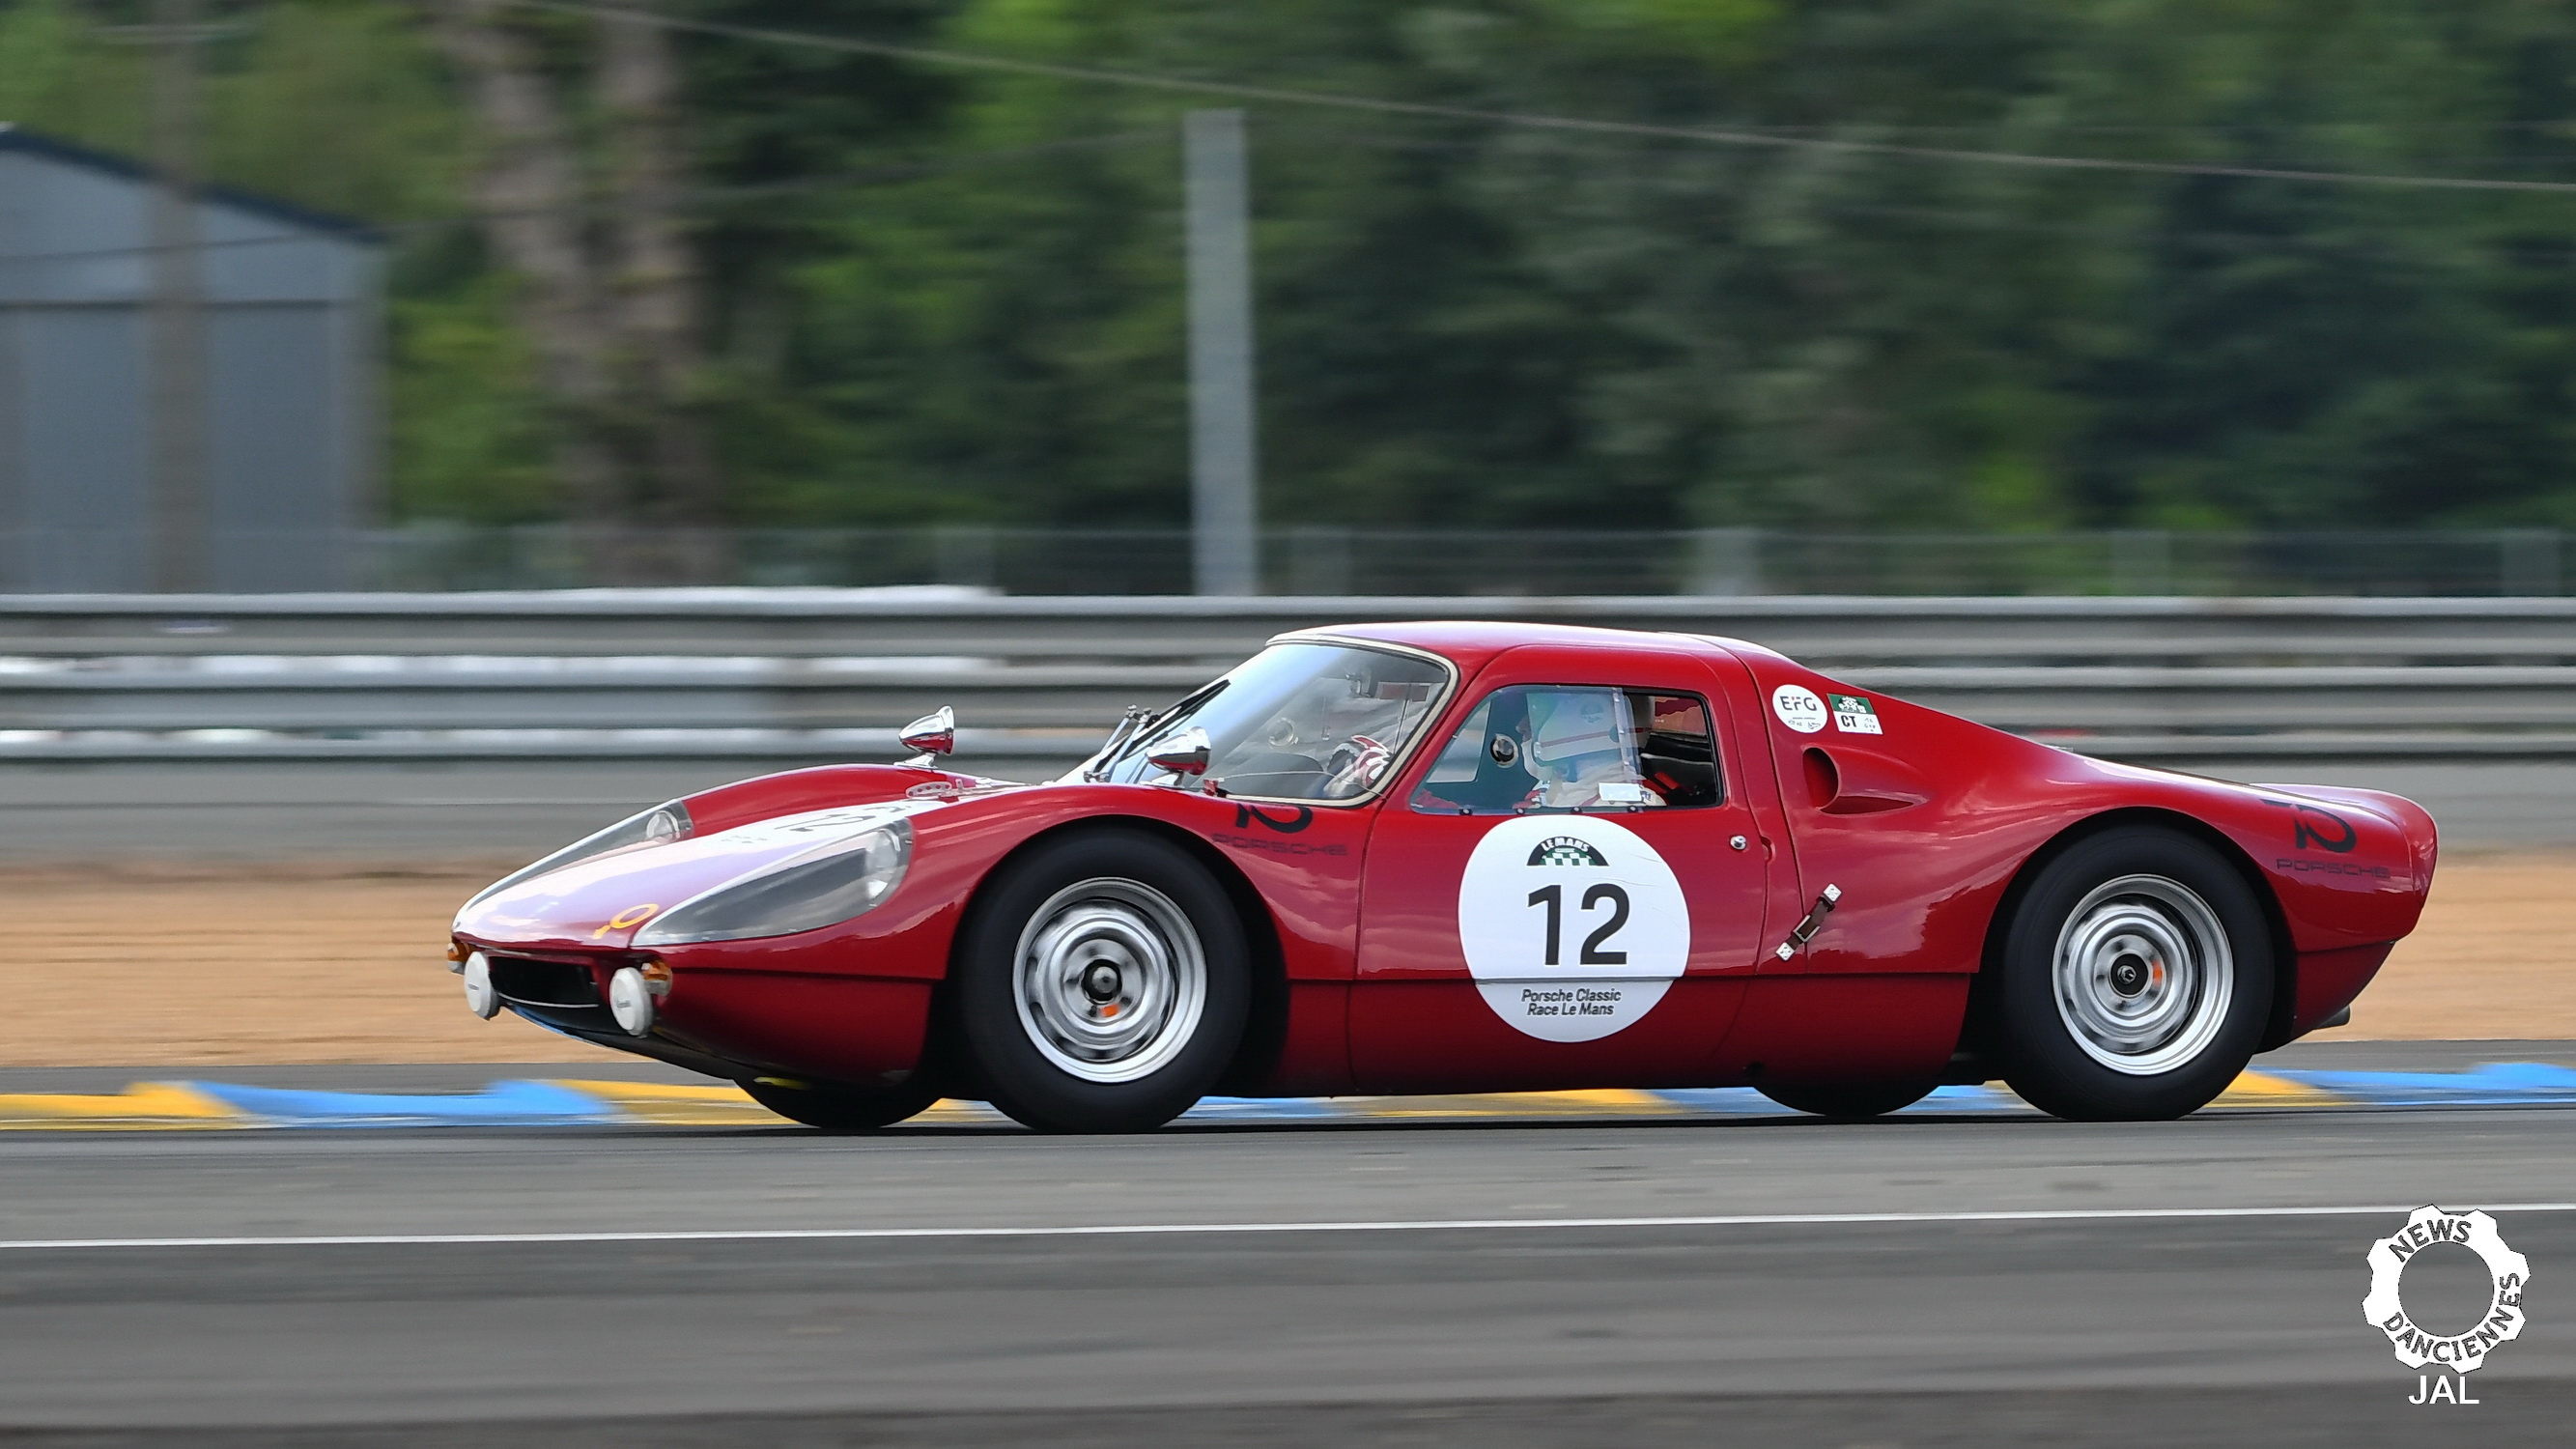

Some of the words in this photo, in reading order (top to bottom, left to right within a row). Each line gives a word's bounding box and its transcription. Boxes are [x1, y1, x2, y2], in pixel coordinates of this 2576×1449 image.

[1779, 696, 1818, 712] EFG
[1840, 715, 1857, 728] CT
[1211, 833, 1348, 857] PORSCHE
[1541, 838, 1554, 852] LE
[1554, 837, 1591, 853] MANS
[2276, 858, 2392, 879] PORSCHE
[1527, 883, 1630, 966] 12
[1521, 988, 1573, 1002] Porsche
[1575, 988, 1622, 1002] Classic
[1527, 1003, 1559, 1015] Race
[1561, 1003, 1577, 1015] Le
[1578, 1002, 1615, 1015] Mans
